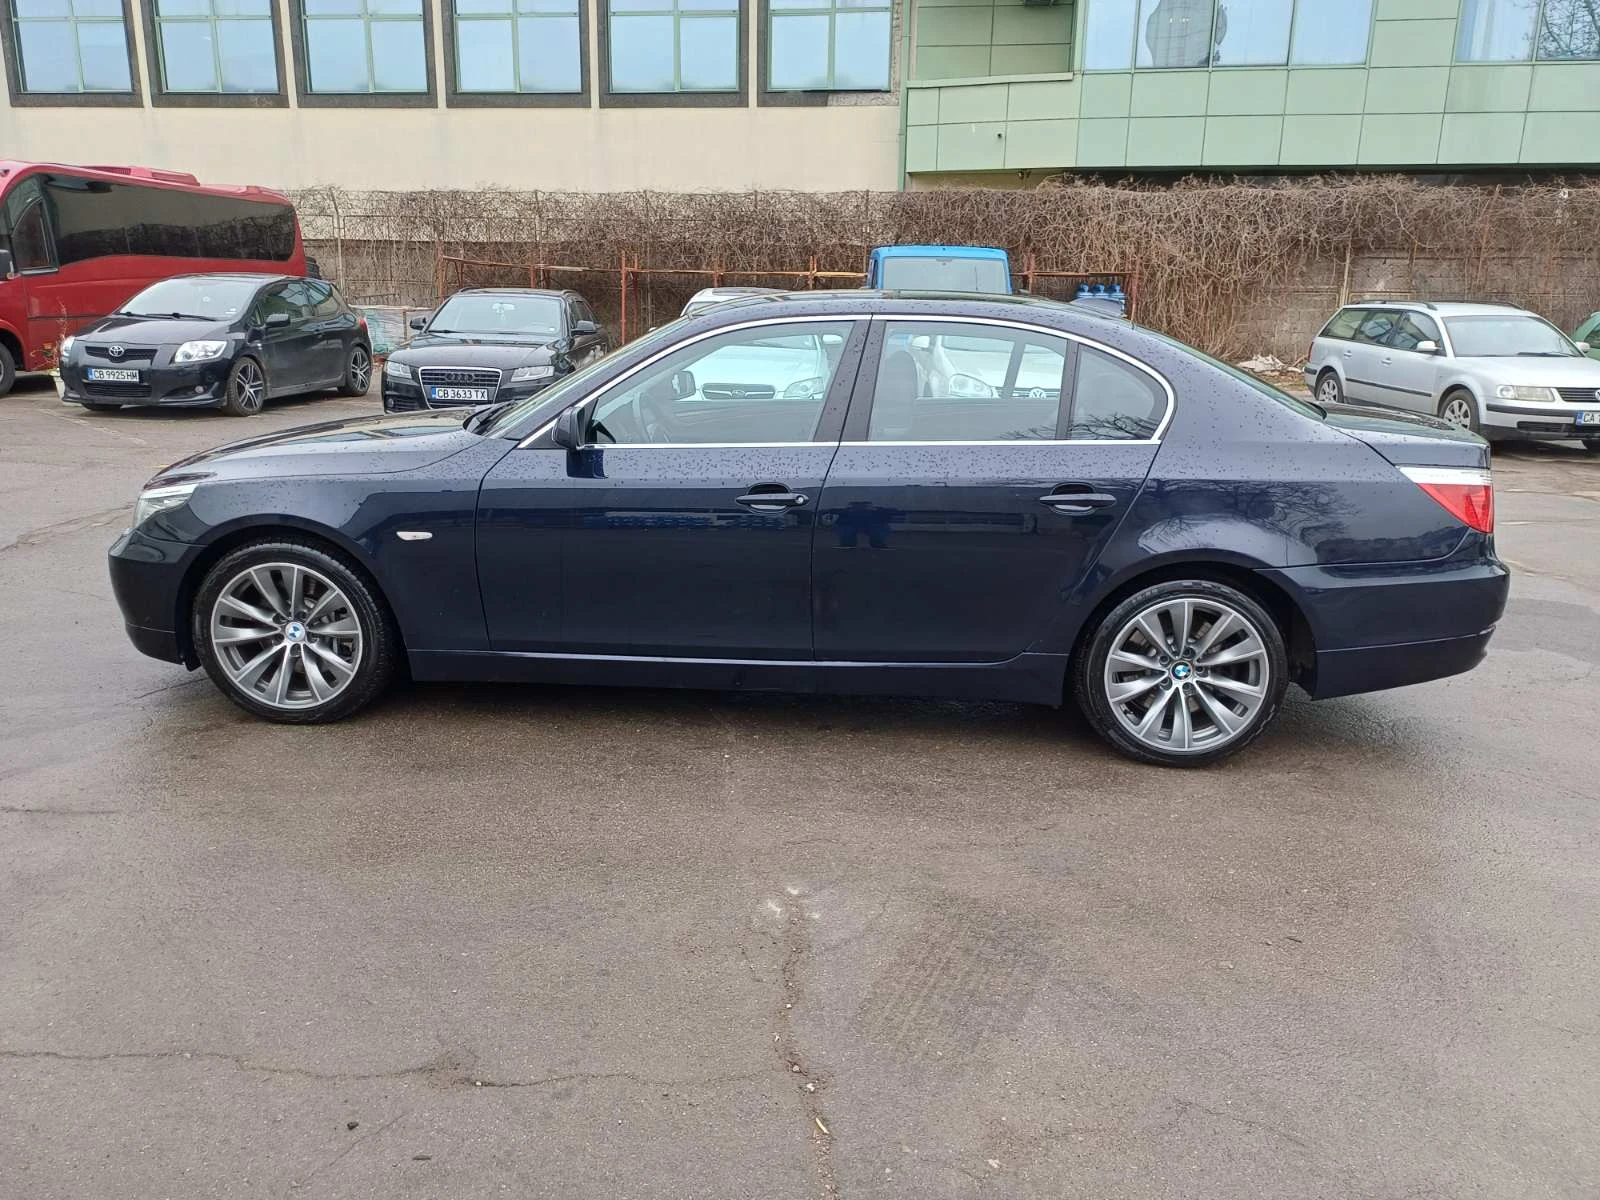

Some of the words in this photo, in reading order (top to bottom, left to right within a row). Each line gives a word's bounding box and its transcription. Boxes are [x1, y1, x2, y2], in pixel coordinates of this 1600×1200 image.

[94, 370, 104, 379] CB
[437, 389, 449, 399] CB
[450, 389, 472, 399] 3633
[474, 390, 486, 399] TX
[1584, 411, 1595, 423] CA
